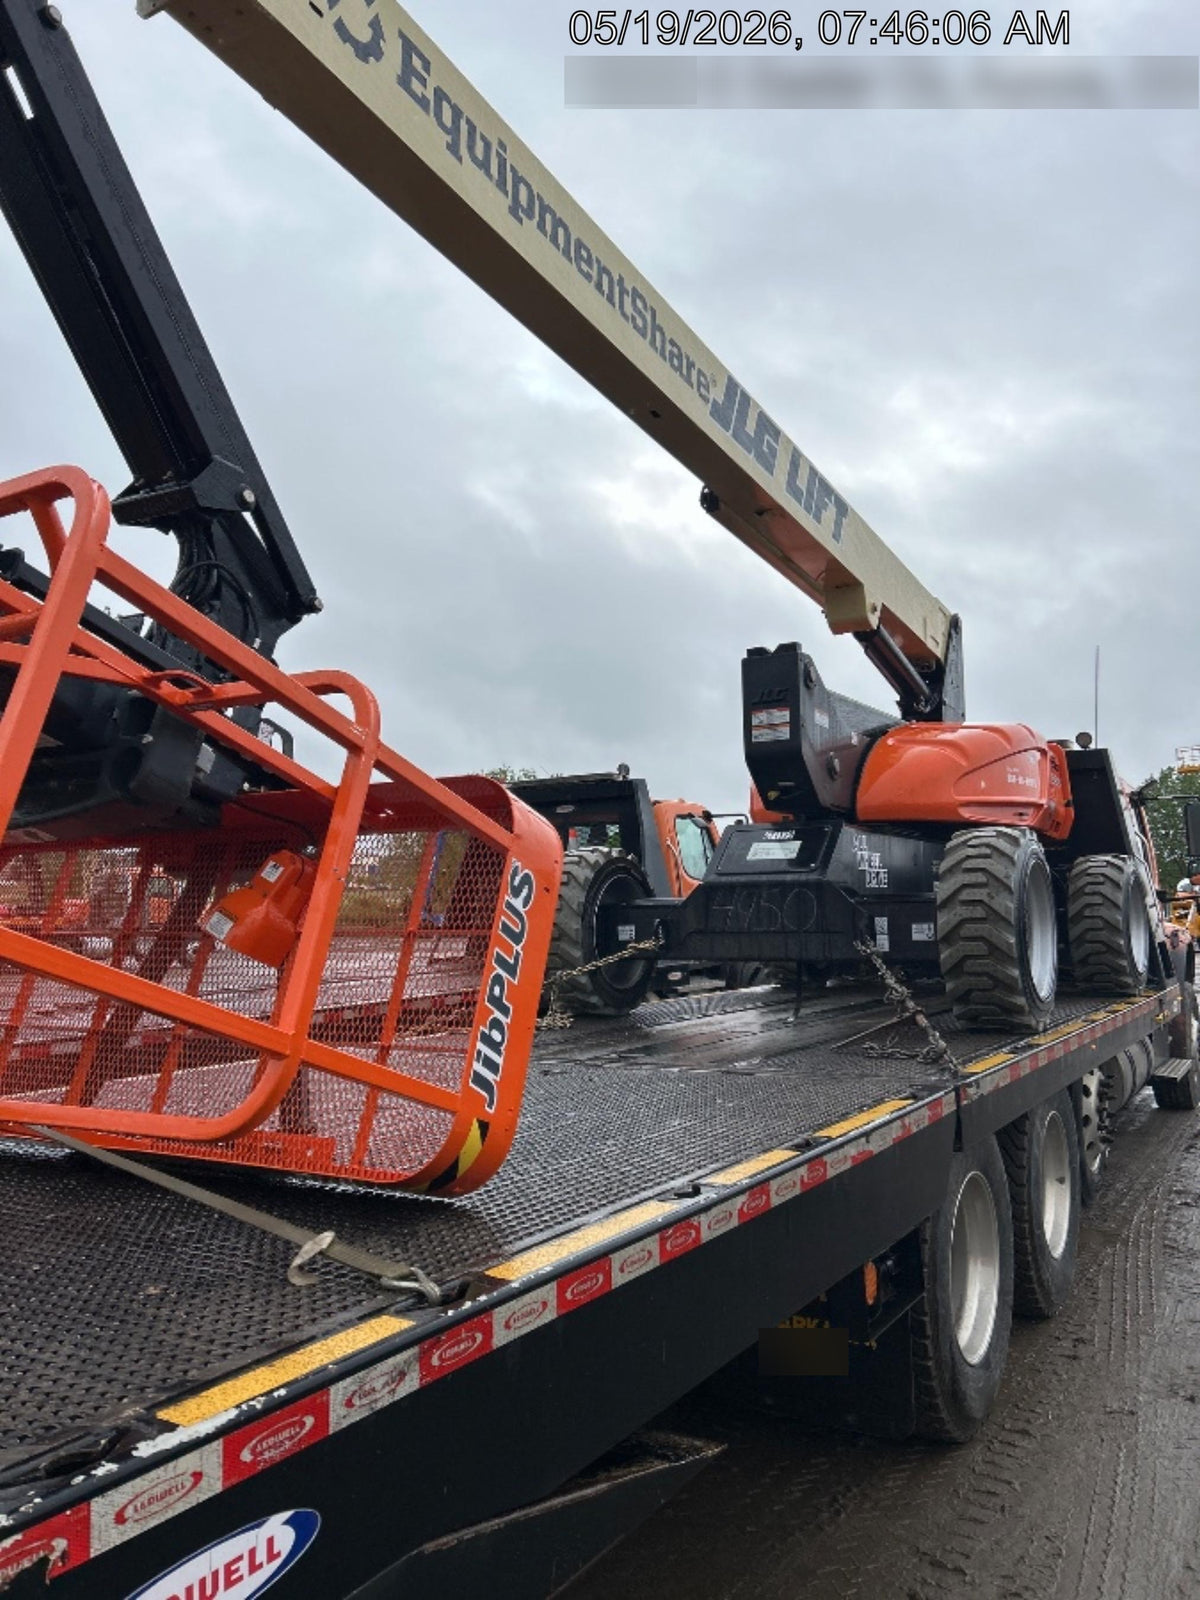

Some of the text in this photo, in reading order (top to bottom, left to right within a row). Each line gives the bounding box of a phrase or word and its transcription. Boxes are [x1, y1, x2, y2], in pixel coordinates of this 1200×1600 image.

[709, 373, 849, 544] JLG LIFT
[469, 857, 536, 1114] JibPLUS
[165, 1535, 282, 1600] WELL
